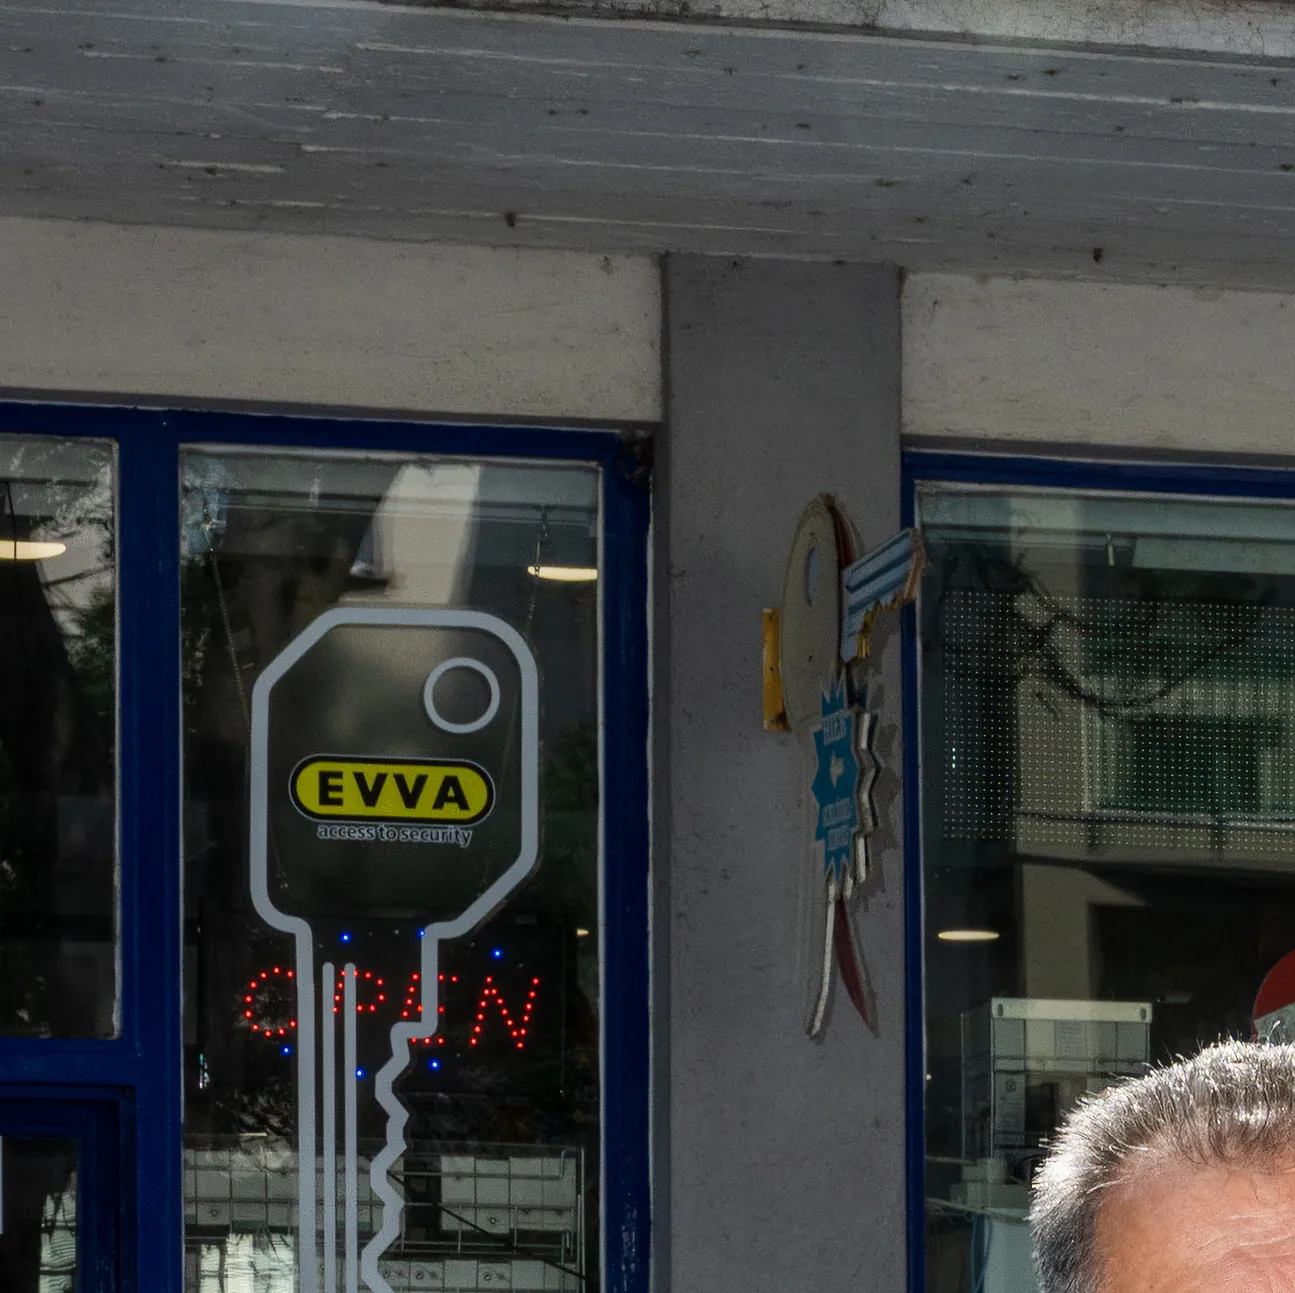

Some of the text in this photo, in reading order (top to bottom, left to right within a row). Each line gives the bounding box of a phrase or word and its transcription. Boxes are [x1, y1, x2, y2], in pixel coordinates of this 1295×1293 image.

[316, 770, 470, 811] EVVA
[317, 824, 472, 848] access to security
[245, 966, 540, 1049] OPEN
